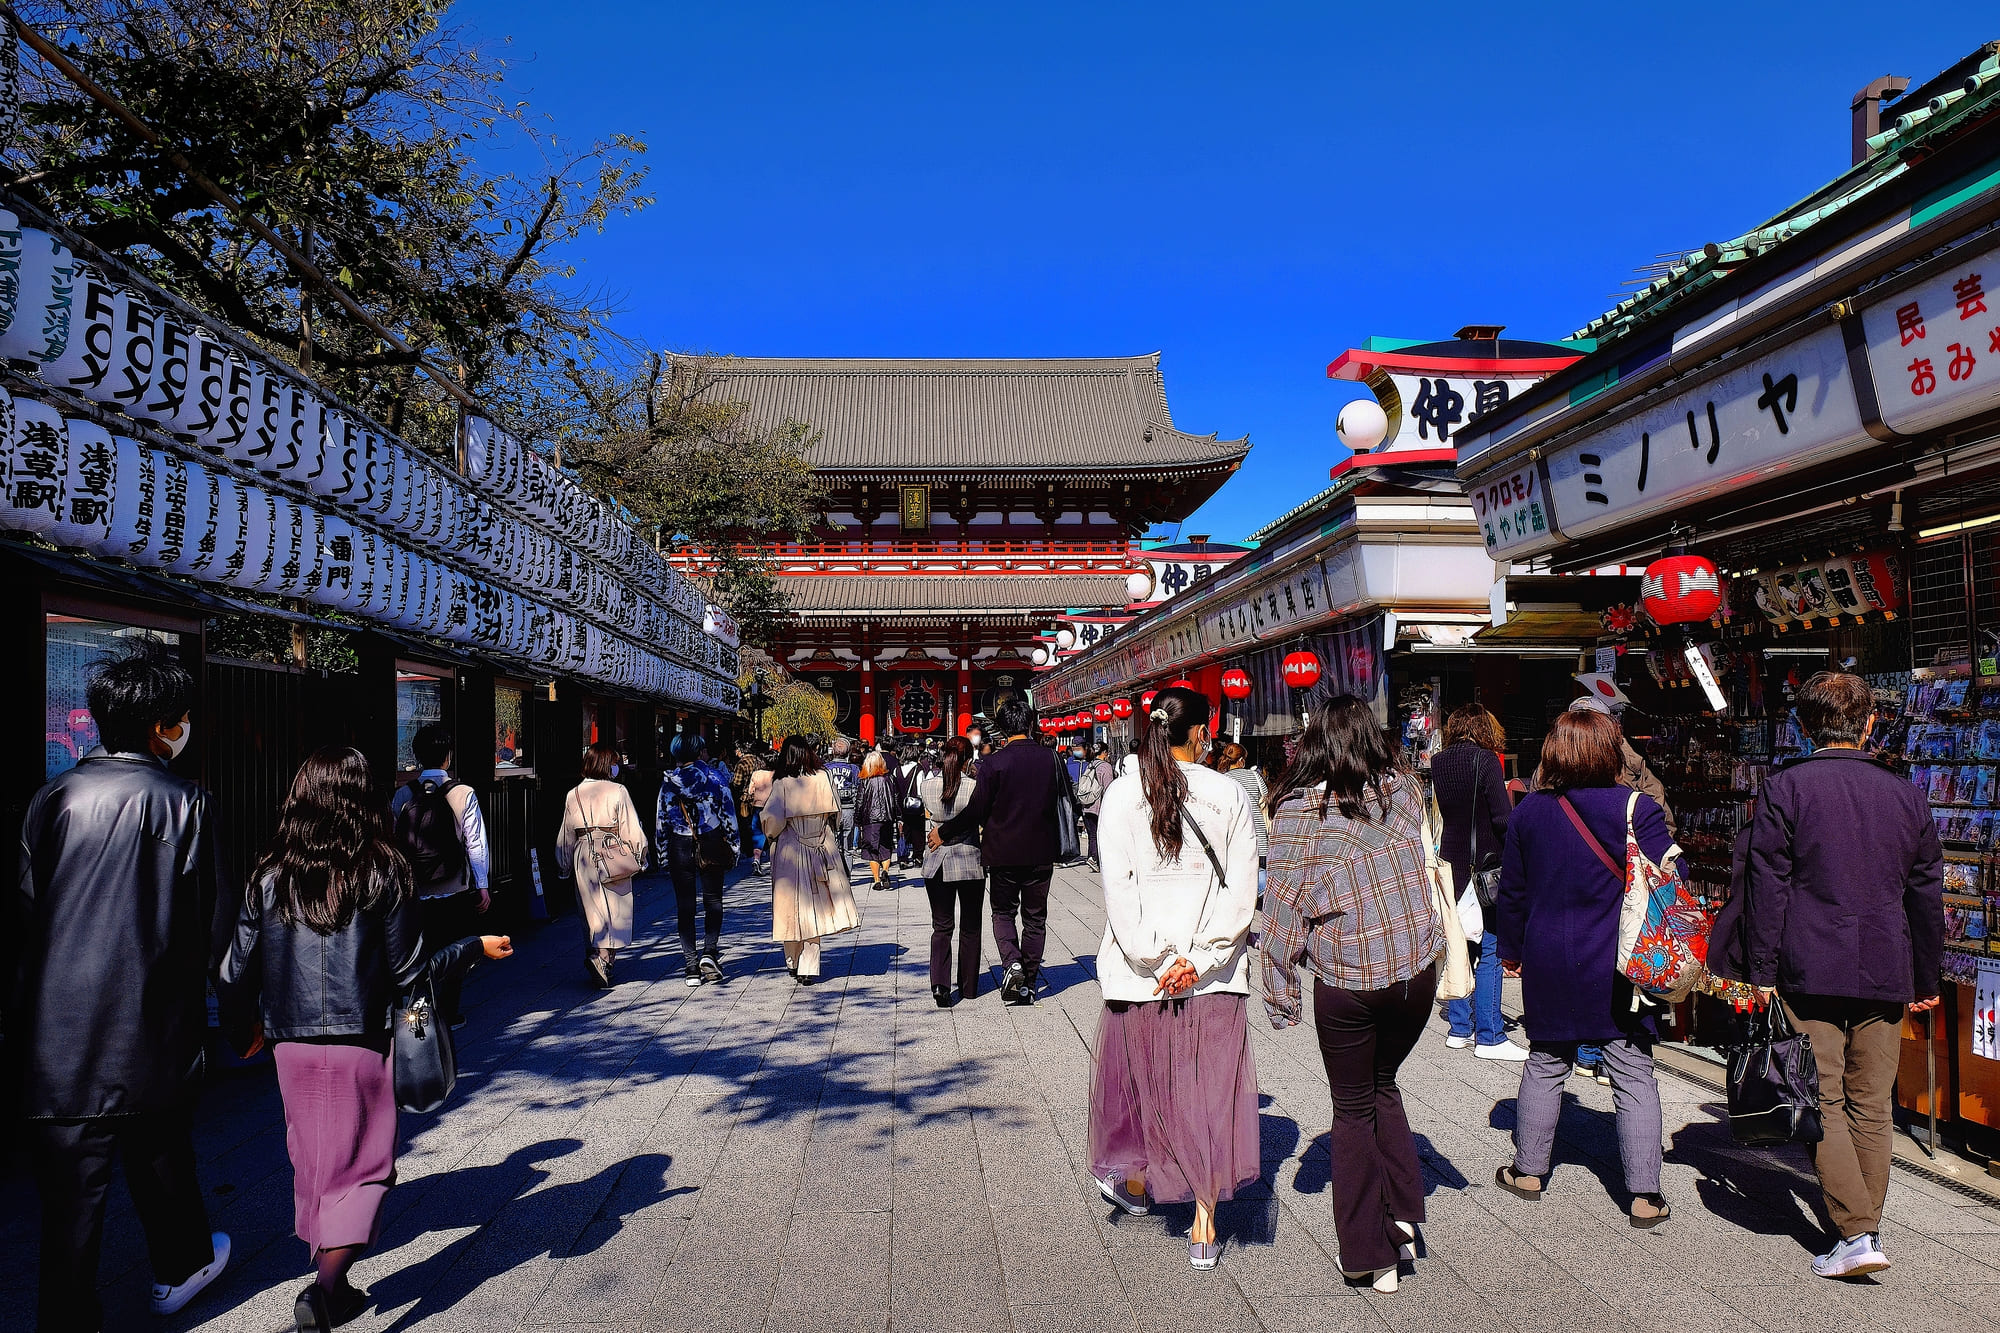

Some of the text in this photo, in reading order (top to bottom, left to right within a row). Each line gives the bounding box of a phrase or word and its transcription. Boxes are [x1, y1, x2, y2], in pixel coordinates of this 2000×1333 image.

[68, 283, 114, 389] FOX
[113, 301, 154, 405] FOX
[147, 322, 190, 420] FOX
[187, 340, 224, 433] FOX
[217, 365, 251, 448] FOX
[248, 377, 280, 462] FOX
[1411, 378, 1509, 442] 仲見
[12, 421, 60, 513] 浅草駅
[1580, 372, 1799, 505] ミノリヤ
[70, 442, 113, 526] 浅草駅
[1475, 470, 1534, 517] フクロモノ
[1483, 502, 1546, 547] みやげ品
[327, 535, 352, 590] 雷門
[1161, 563, 1213, 596] 仲見
[832, 767, 851, 777] ALPH
